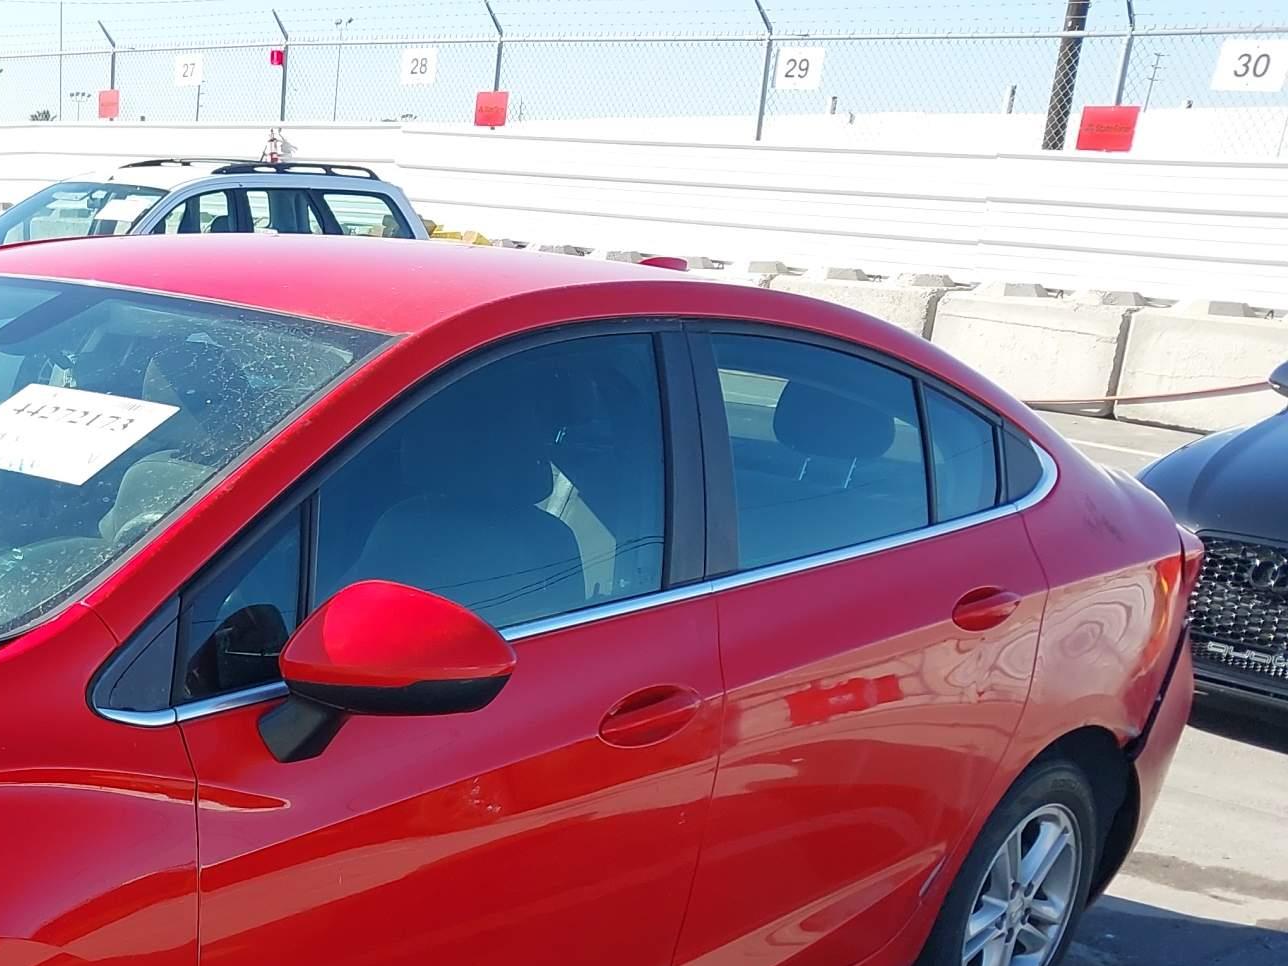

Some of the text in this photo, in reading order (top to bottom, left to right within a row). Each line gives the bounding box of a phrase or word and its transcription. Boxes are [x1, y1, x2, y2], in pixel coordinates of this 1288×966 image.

[182, 62, 196, 78] 27
[410, 57, 428, 75] 28
[784, 58, 809, 79] 29
[1233, 53, 1271, 78] 30
[12, 402, 135, 431] 44272173
